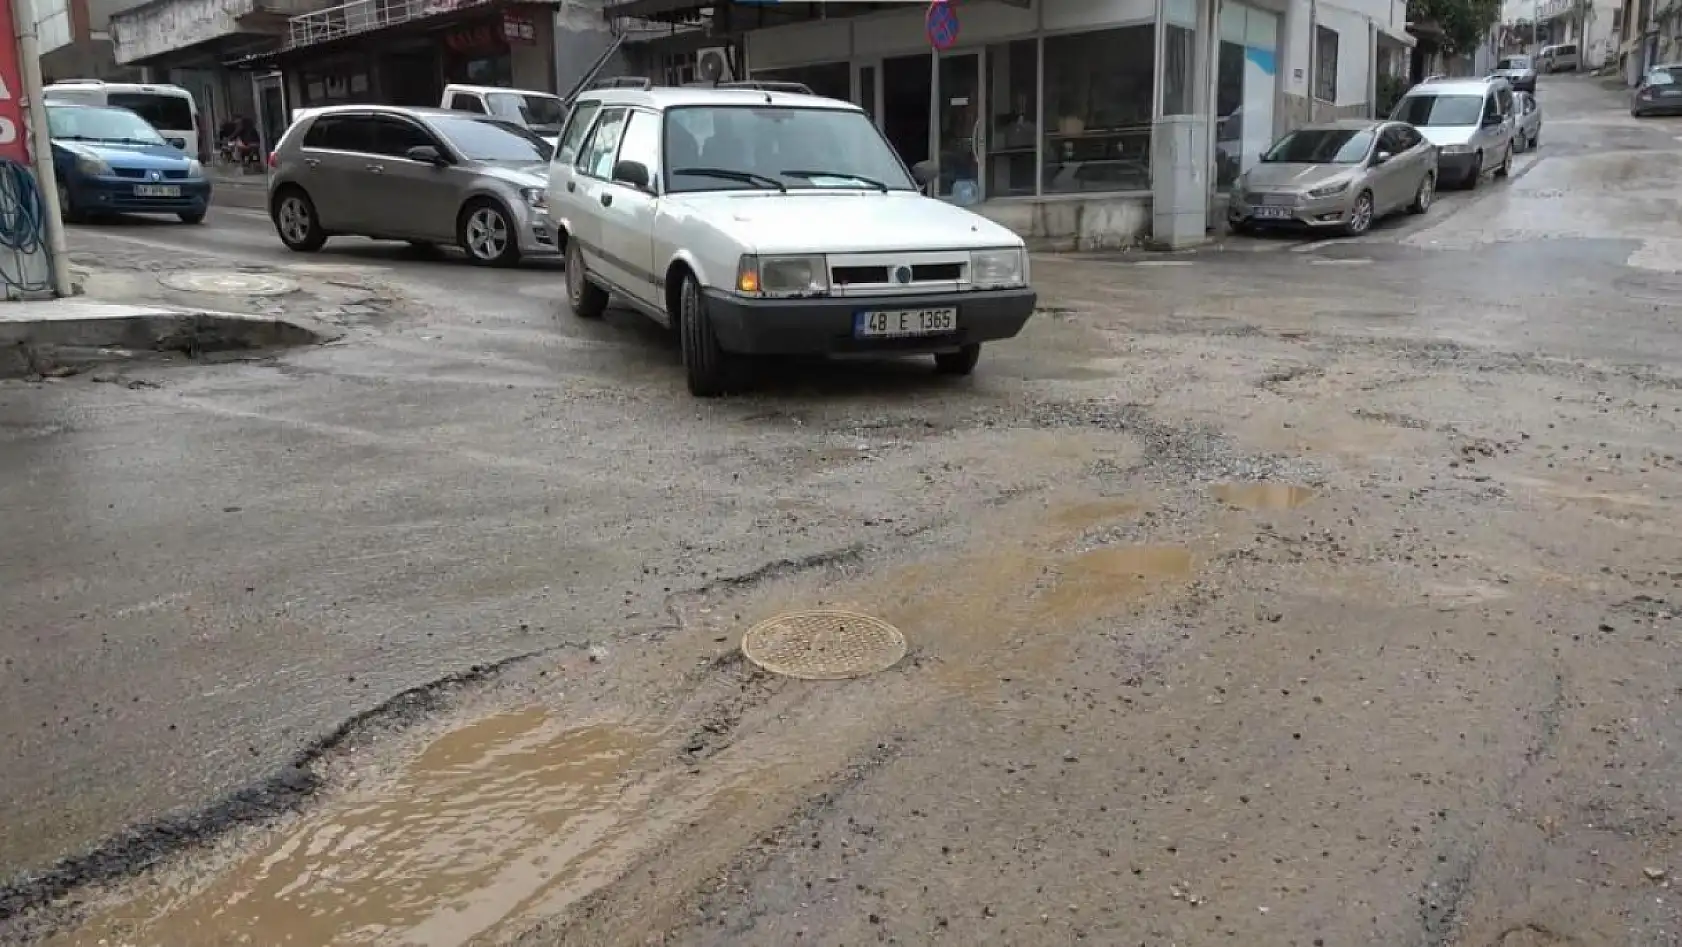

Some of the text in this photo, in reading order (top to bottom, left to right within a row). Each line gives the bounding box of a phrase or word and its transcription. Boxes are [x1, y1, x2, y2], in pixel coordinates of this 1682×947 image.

[869, 309, 951, 331] 48 E 1365
